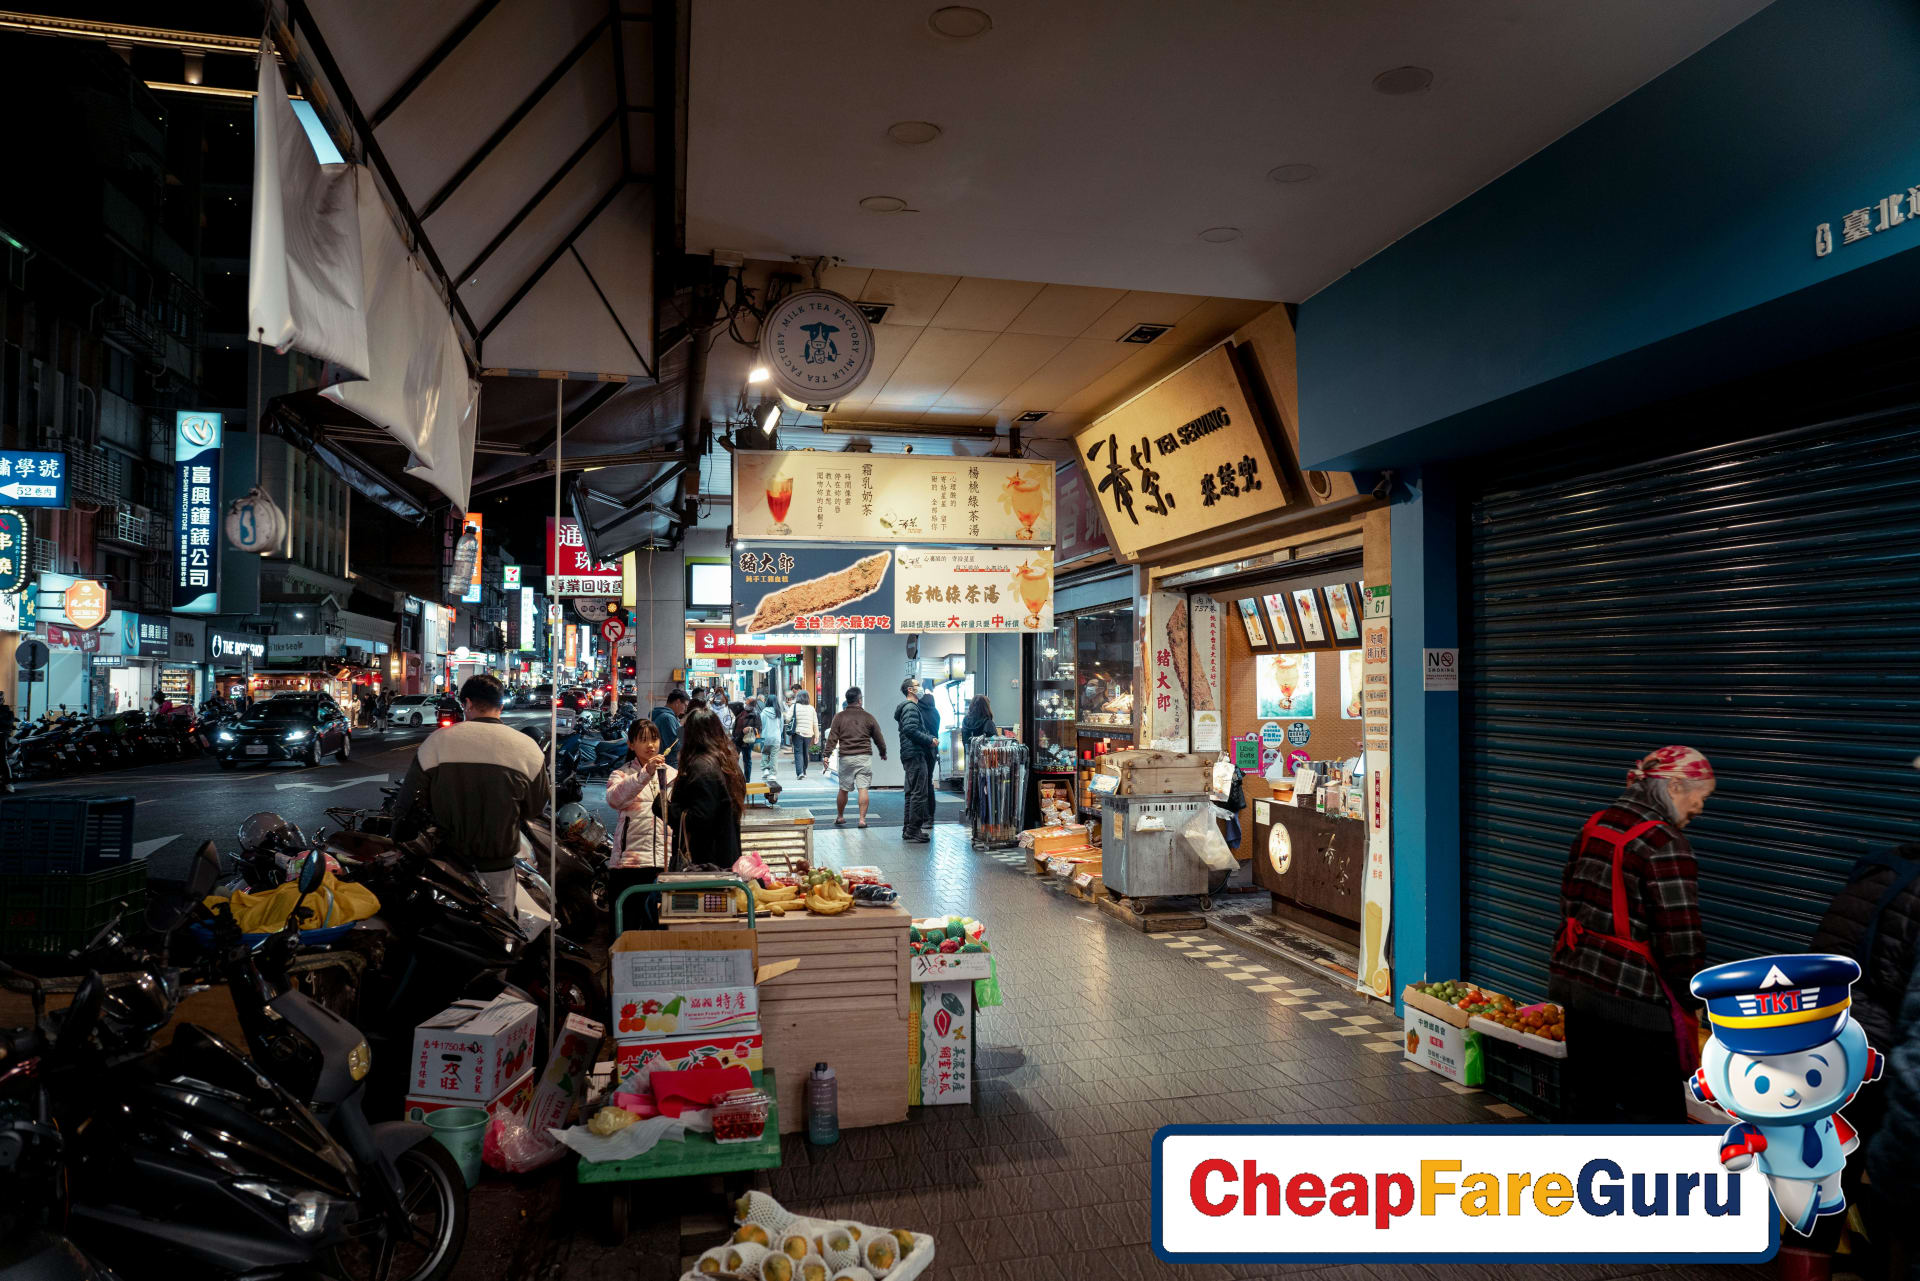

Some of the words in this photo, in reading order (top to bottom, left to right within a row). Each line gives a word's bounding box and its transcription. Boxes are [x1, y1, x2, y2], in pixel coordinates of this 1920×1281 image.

[781, 305, 806, 328] MILK
[808, 303, 831, 311] TEA
[833, 307, 860, 353] FACTORY
[807, 374, 828, 383] TEA
[1153, 432, 1181, 456] TEA
[1177, 406, 1231, 446] SERVING
[862, 463, 873, 517] 霜乳奶茶
[968, 466, 980, 537] 楊桃綠茶湯
[189, 465, 211, 587] 富興鐘錶公司
[905, 584, 1001, 604] 楊桃綠茶湯
[1375, 600, 1385, 613] 61
[222, 640, 234, 655] THE
[794, 616, 890, 629] 全台最大最好吃
[1157, 648, 1172, 712] 豬大郎
